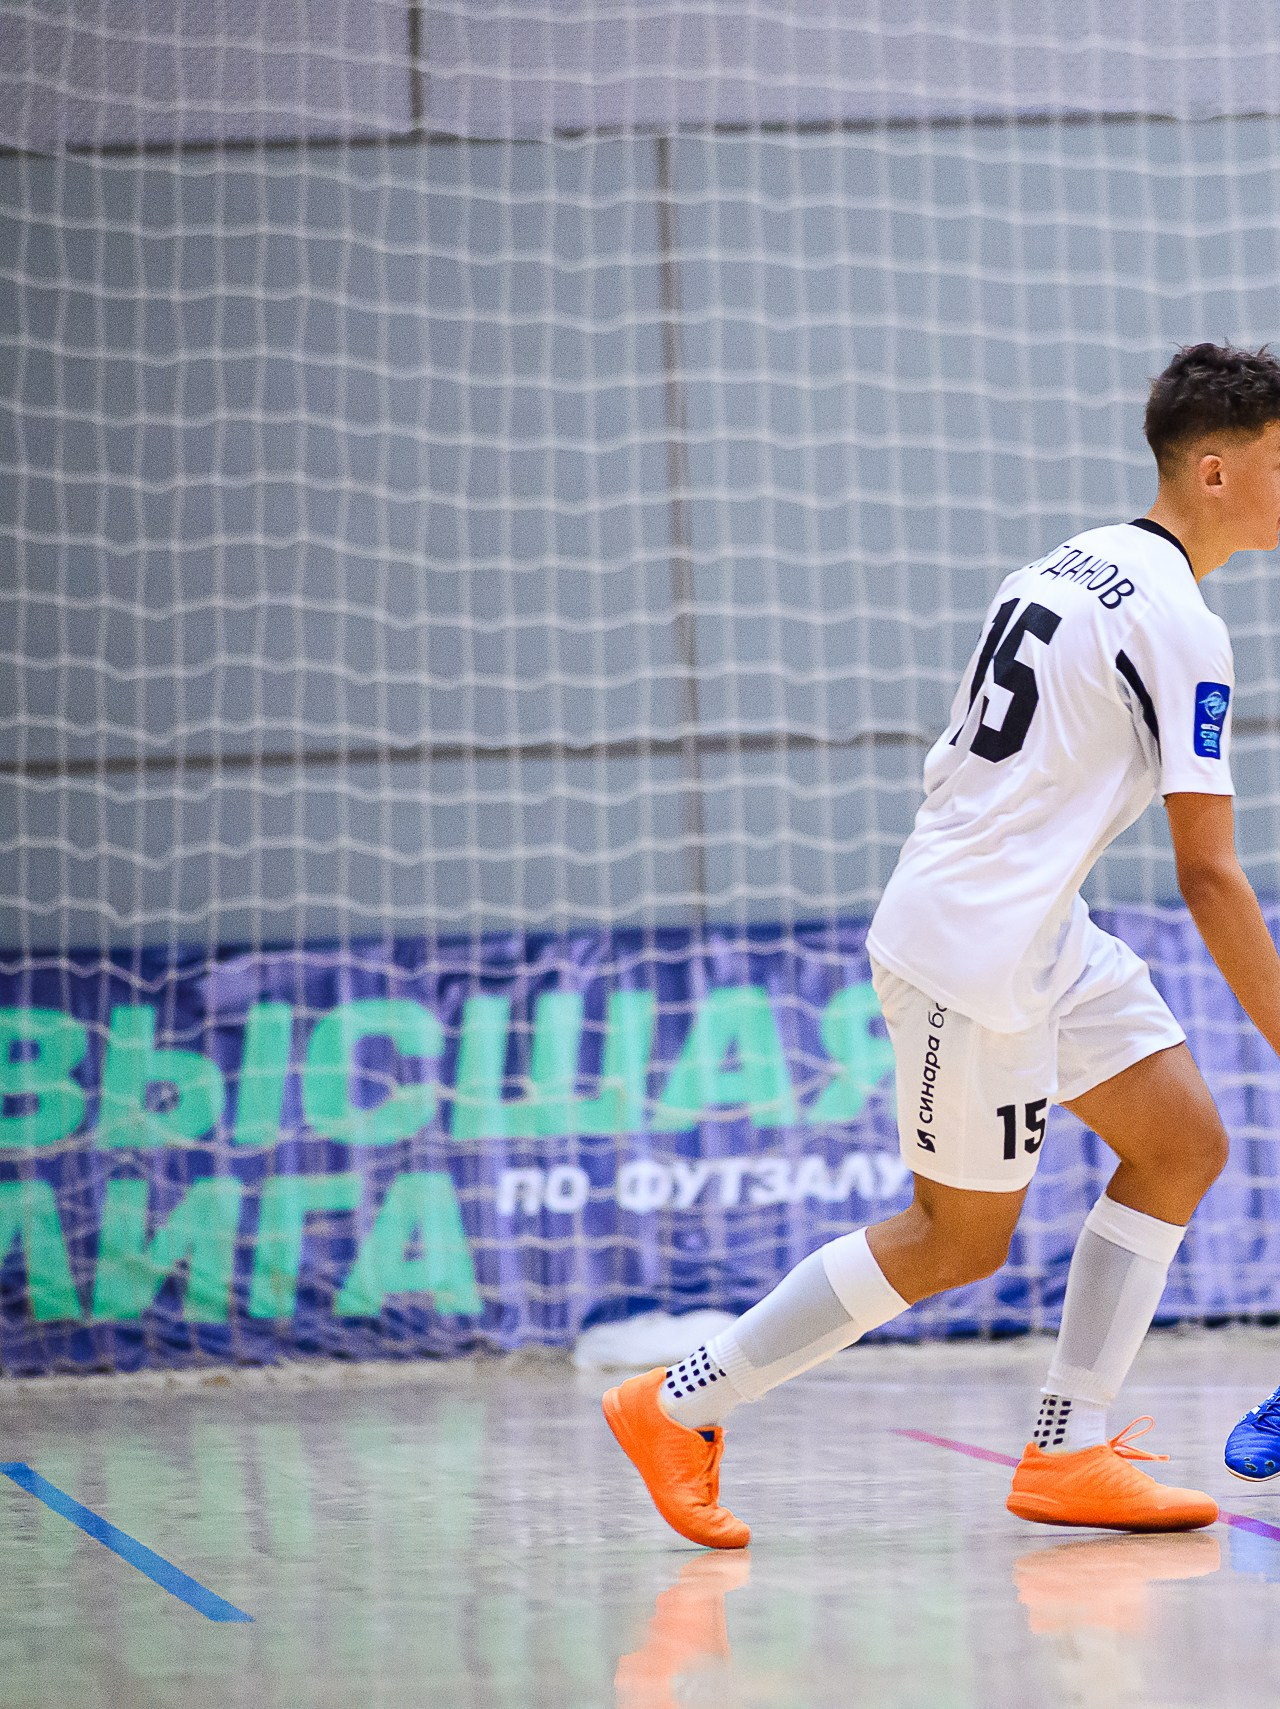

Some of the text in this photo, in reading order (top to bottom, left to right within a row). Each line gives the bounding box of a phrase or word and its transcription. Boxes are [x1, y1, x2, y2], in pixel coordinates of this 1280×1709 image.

[949, 597, 1062, 763] 15
[0, 981, 898, 1149] ВЫСШАЯ
[919, 1034, 941, 1124] синара
[996, 1098, 1048, 1160] 15
[497, 1152, 910, 1216] ПО ФУТЗАЛУ
